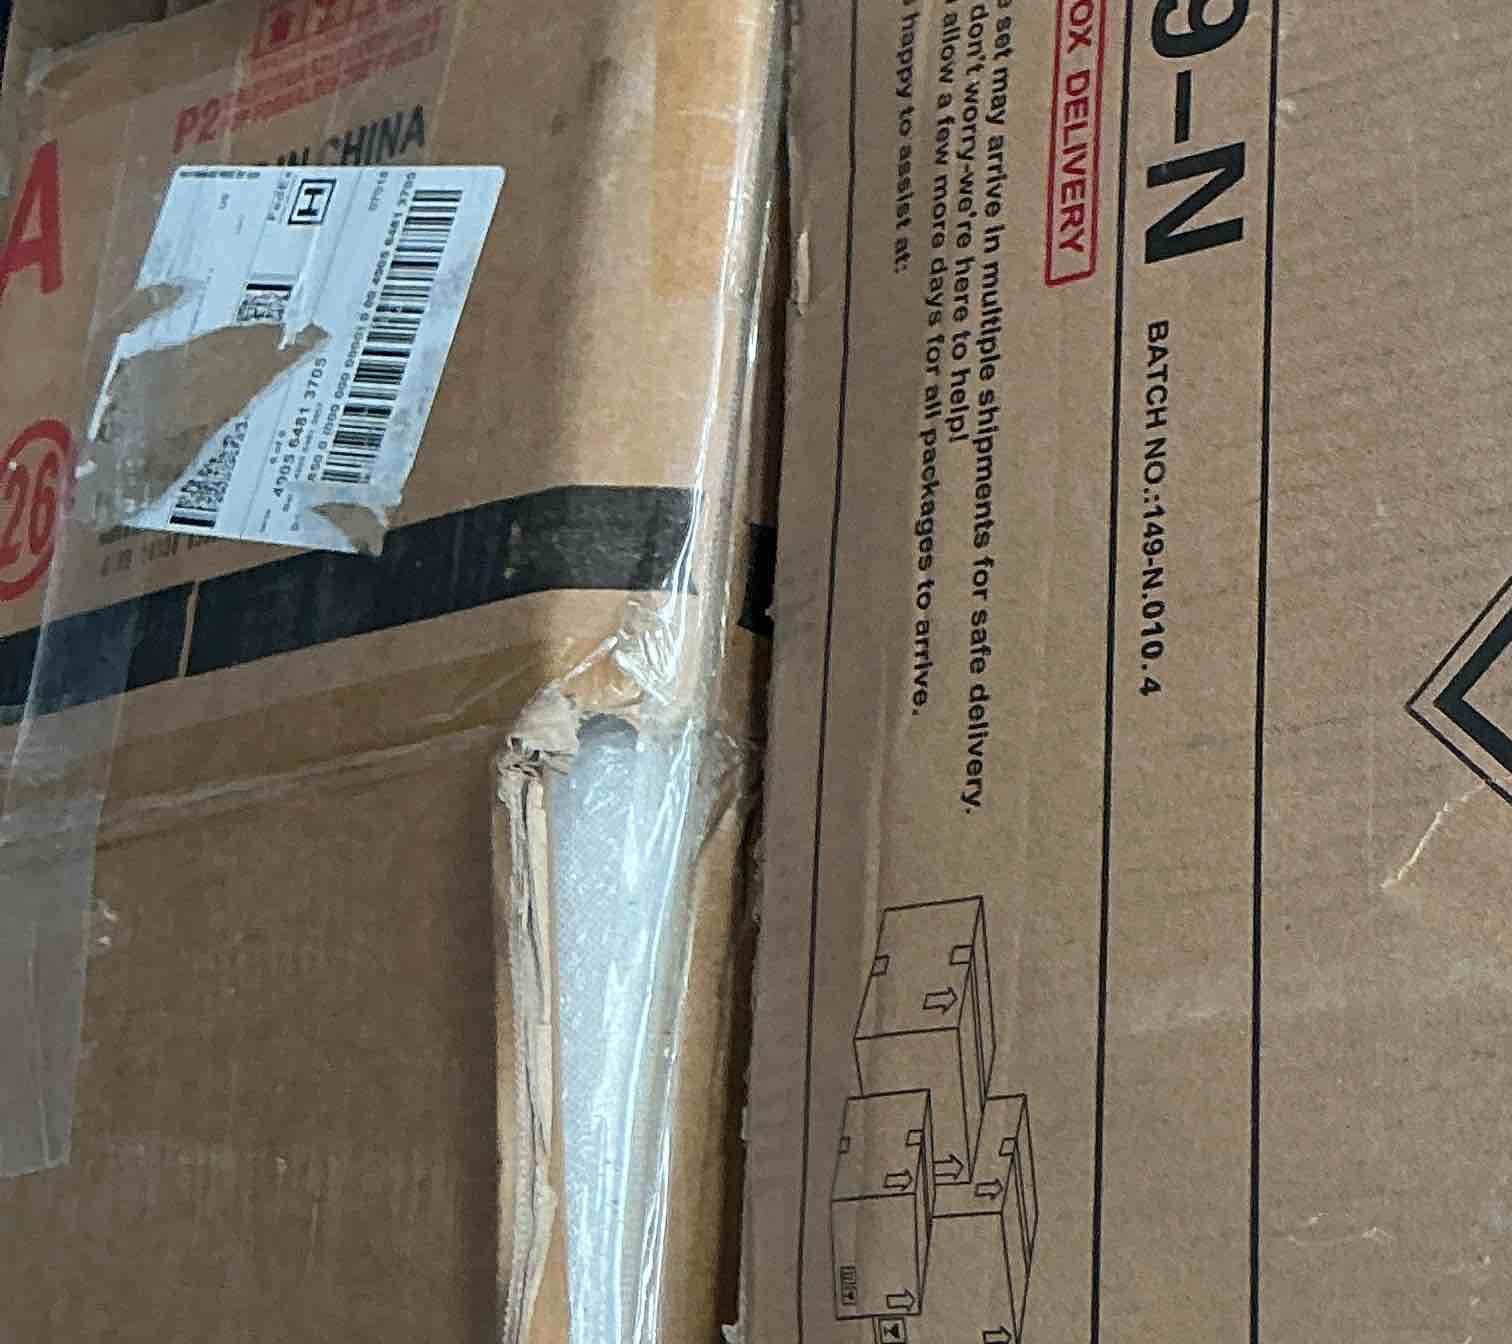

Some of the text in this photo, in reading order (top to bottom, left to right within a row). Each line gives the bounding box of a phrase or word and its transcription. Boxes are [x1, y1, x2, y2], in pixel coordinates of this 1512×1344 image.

[896, 12, 920, 98] happy
[939, 13, 960, 83] allow
[966, 5, 989, 76] don't
[993, 16, 1013, 60] set
[899, 106, 914, 136] to
[937, 93, 952, 109] a
[985, 67, 1008, 124] may
[934, 116, 955, 165] few
[1059, 69, 1090, 252] DELIVERY
[896, 145, 914, 228] assist
[985, 136, 1007, 217] arrive
[932, 175, 947, 248] more
[984, 224, 1005, 253] in
[925, 258, 948, 326] days
[953, 257, 975, 322] here
[977, 262, 1002, 381] multiple
[926, 334, 945, 376] for
[952, 331, 971, 360] to
[1144, 319, 1170, 430] BATCH
[925, 384, 942, 419] all
[946, 368, 970, 443] help!
[915, 428, 940, 571] packages
[973, 390, 998, 548] shipments
[916, 579, 934, 610] to
[973, 556, 994, 601] for
[912, 620, 933, 715] arrive.
[970, 610, 991, 674] safe
[963, 684, 988, 814] delivery.
